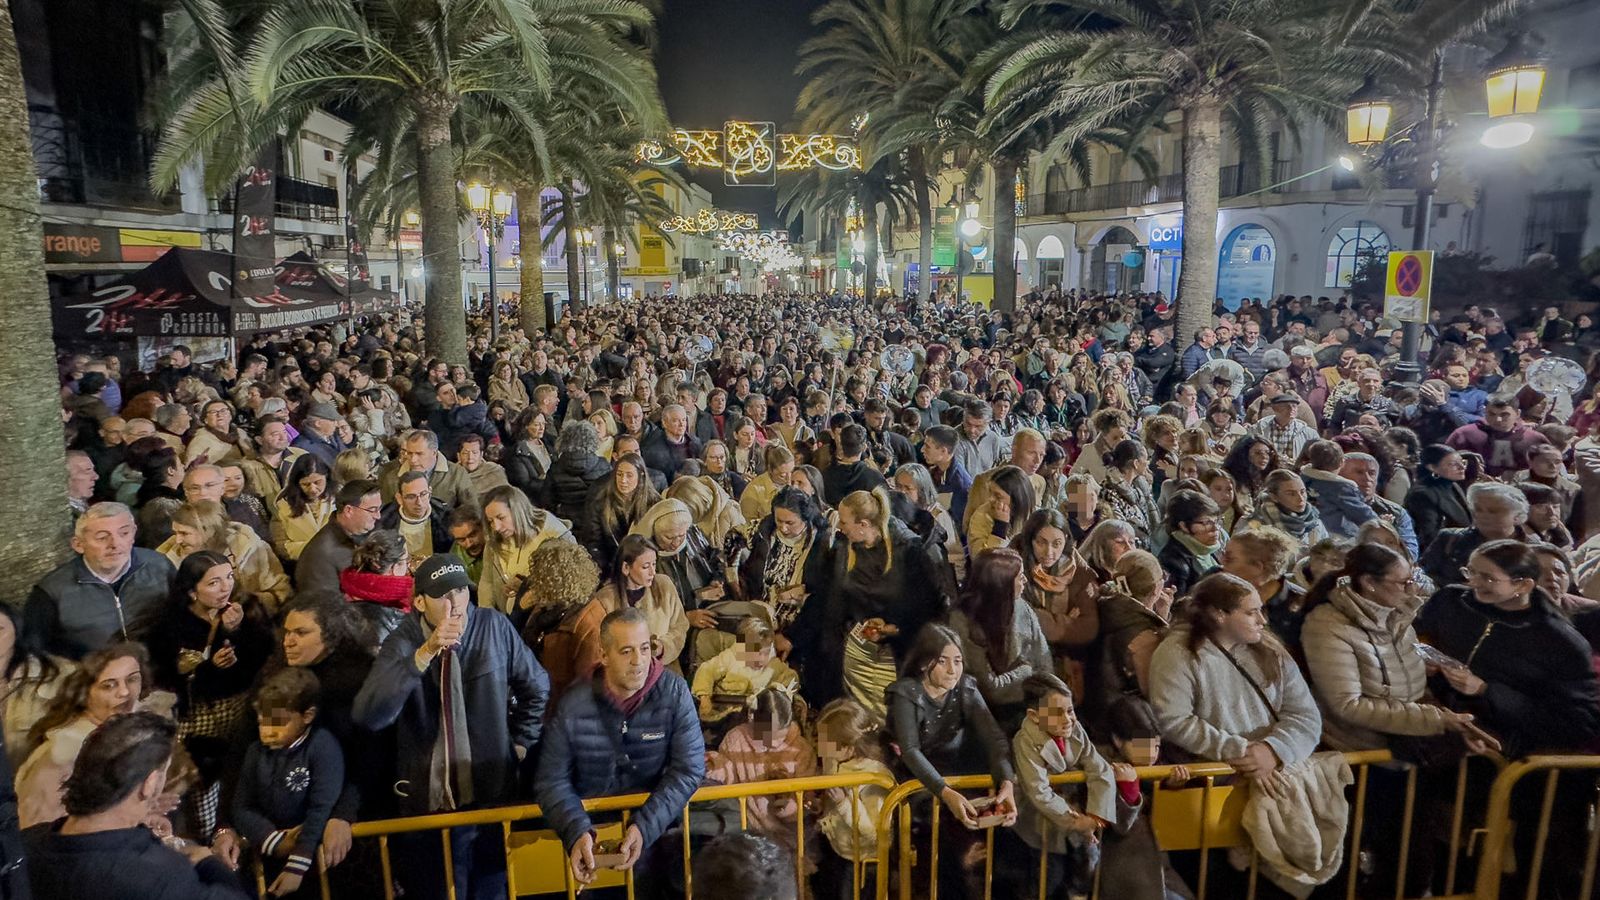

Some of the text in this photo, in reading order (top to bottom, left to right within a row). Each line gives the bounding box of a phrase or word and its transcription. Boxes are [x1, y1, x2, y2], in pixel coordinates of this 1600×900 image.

[1151, 227, 1182, 242] aCT
[43, 235, 101, 257] range
[181, 312, 219, 322] COSTA
[430, 563, 465, 580] adidas
